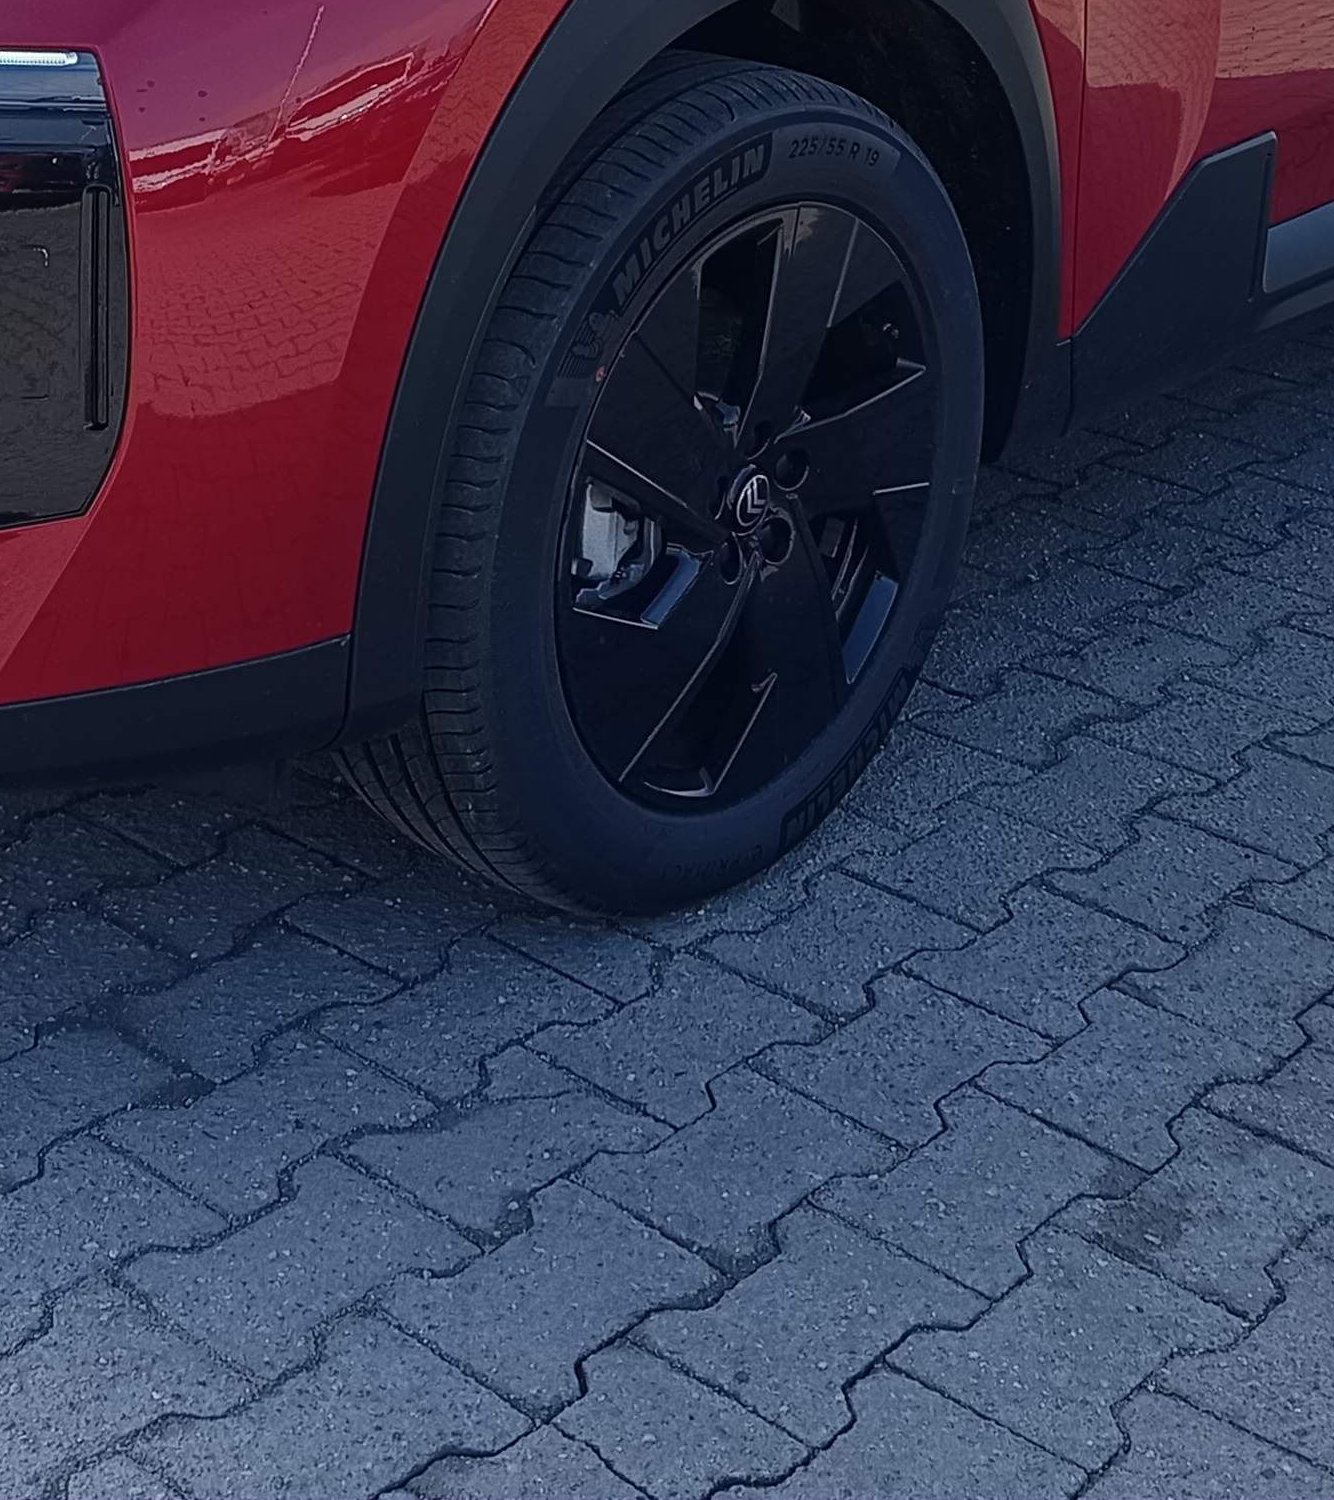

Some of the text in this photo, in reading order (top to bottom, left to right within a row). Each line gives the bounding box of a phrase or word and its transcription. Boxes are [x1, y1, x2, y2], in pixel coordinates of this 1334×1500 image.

[788, 136, 880, 167] 225/55 R 19
[613, 144, 764, 306] MICHELIN
